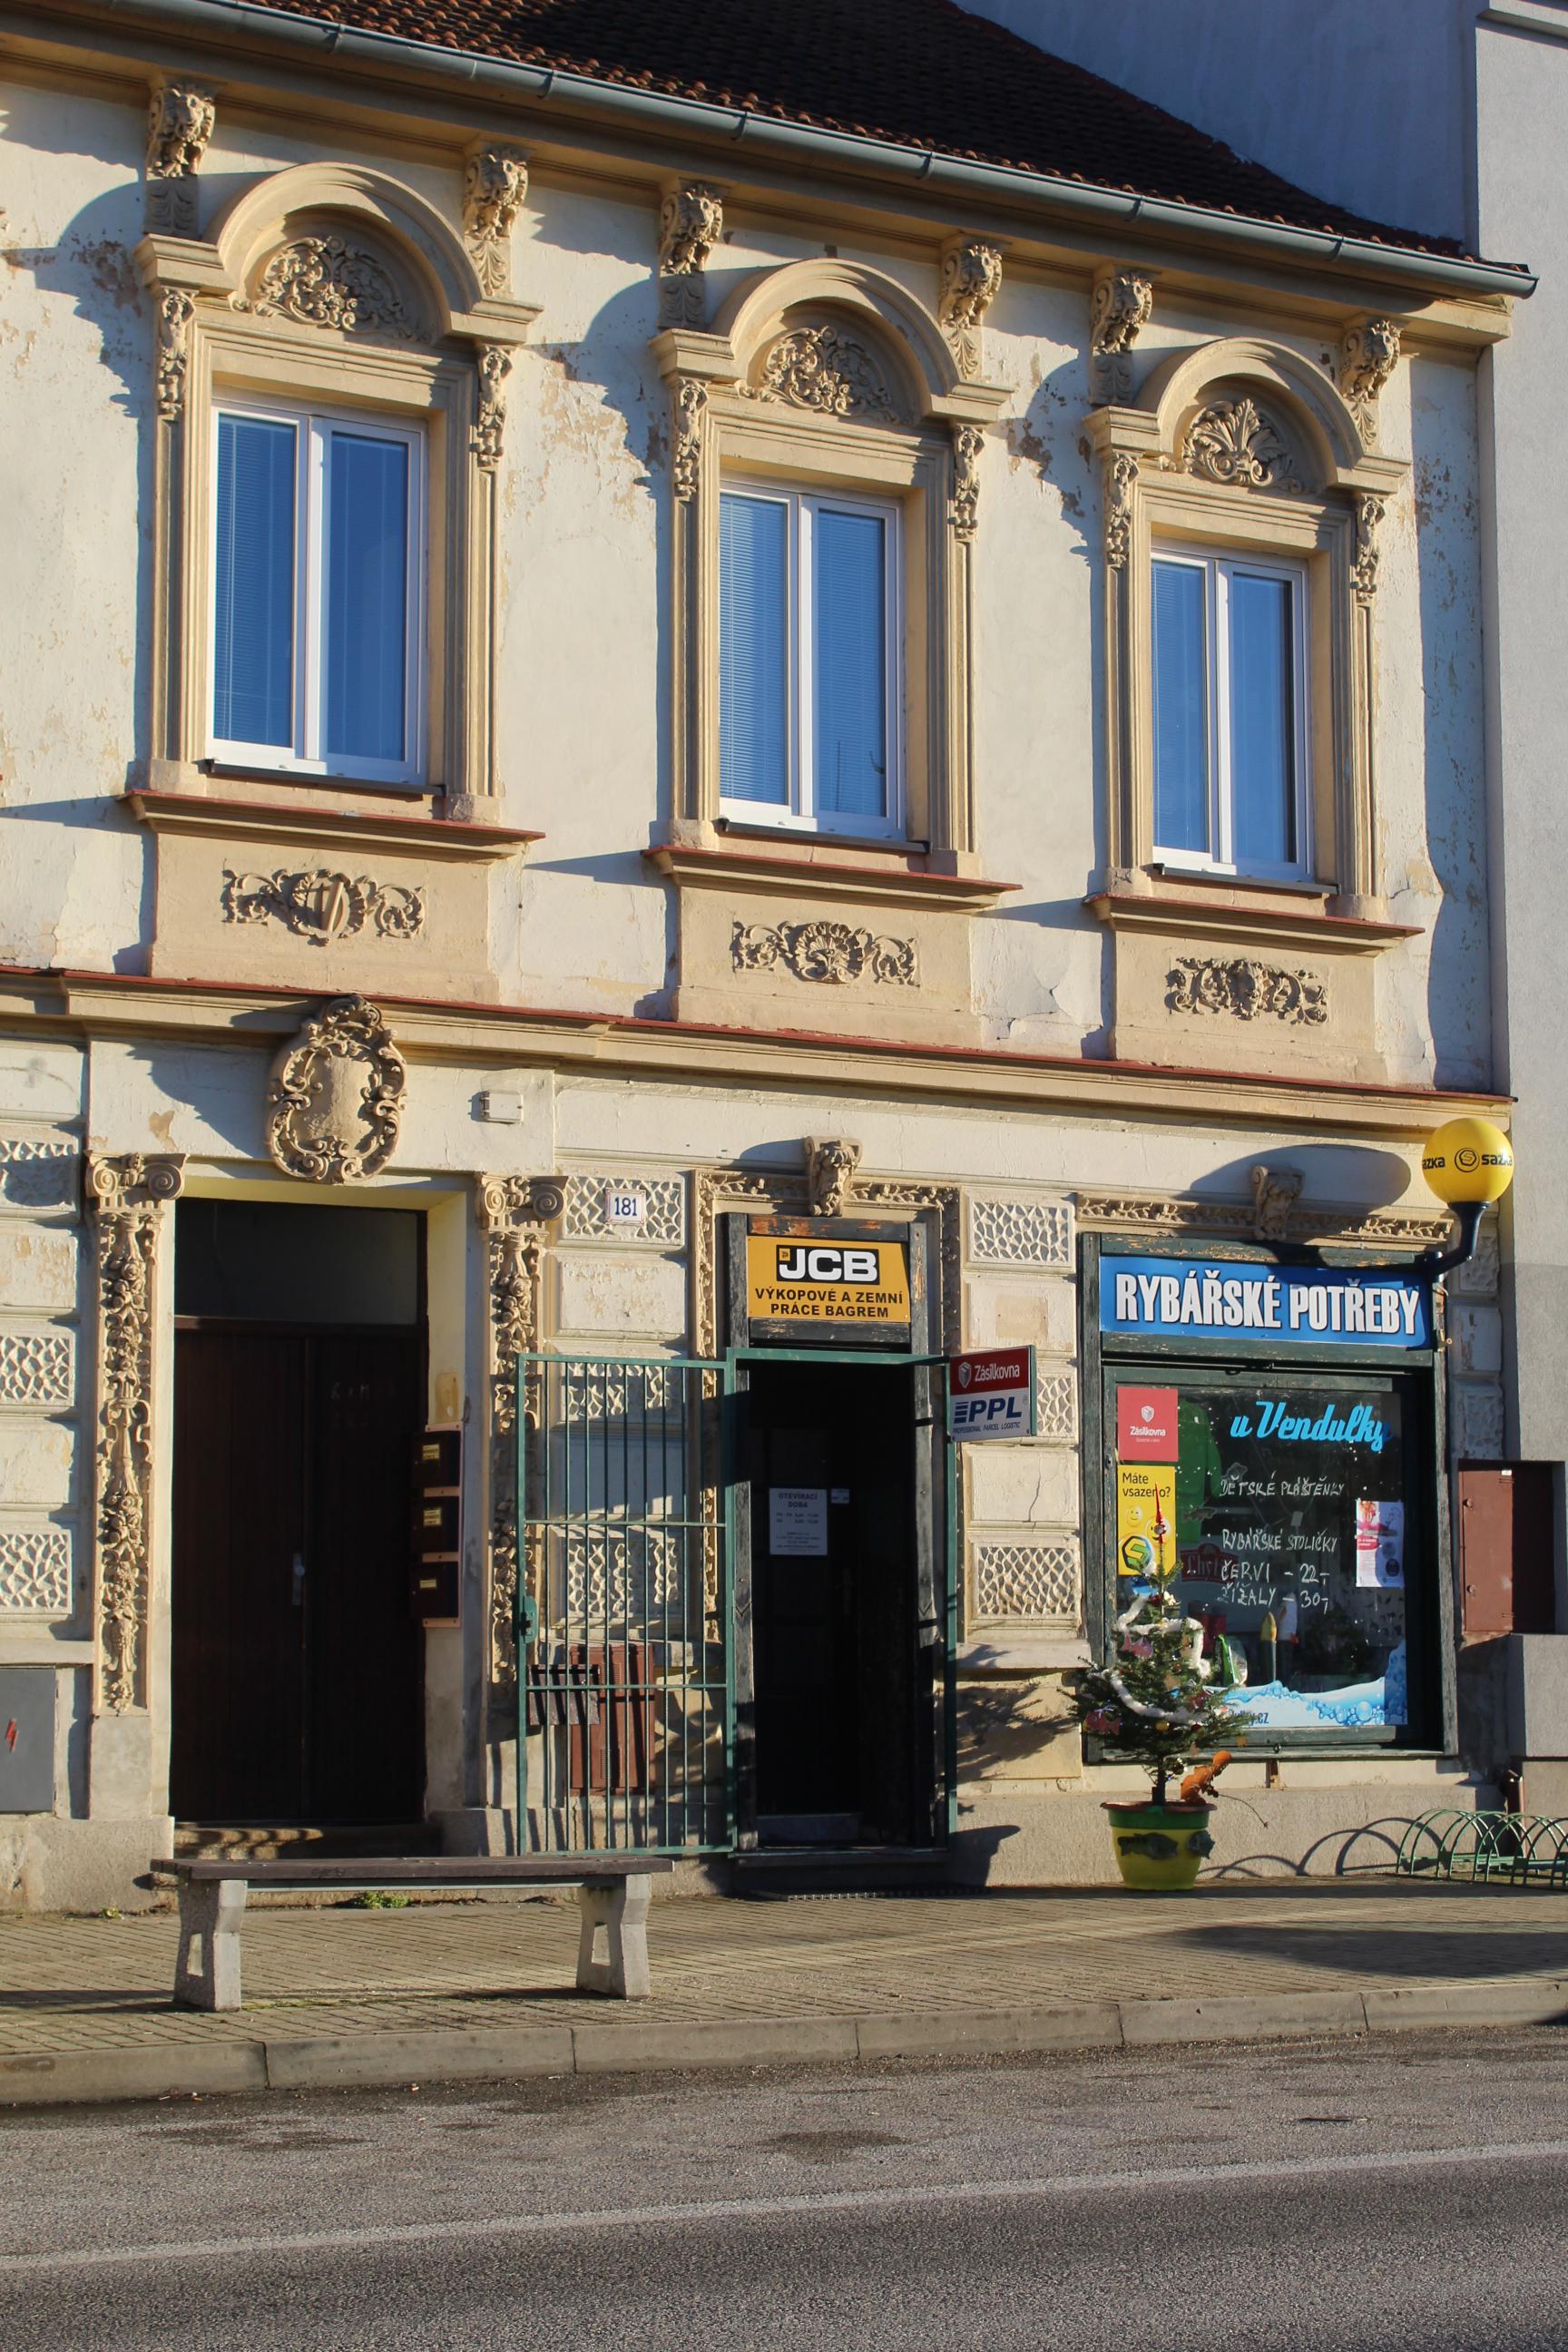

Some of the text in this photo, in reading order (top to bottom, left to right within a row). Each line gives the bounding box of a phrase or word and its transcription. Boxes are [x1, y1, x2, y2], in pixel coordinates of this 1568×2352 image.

[1423, 1156, 1446, 1170] azka
[614, 1197, 637, 1217] 181
[779, 1248, 878, 1282] JCB
[755, 1286, 903, 1304] VÝKOPOVÉ A ZEMNÍ
[1115, 1269, 1420, 1335] RYBÁŘSKÉ POTŘEBY
[770, 1301, 888, 1318] PRÁCE BAGREM
[974, 1363, 1020, 1382] Zásilkovna
[968, 1396, 1023, 1423] PPL
[1130, 1426, 1166, 1436] Zásilkovna
[1230, 1401, 1394, 1452] u Vendulky
[1122, 1472, 1149, 1485] Máte
[1220, 1470, 1277, 1496] DĚTSKÉ
[1221, 1527, 1338, 1553] RYBÁŘSKÉ STOLIČKY
[1220, 1560, 1270, 1583] ČERVI
